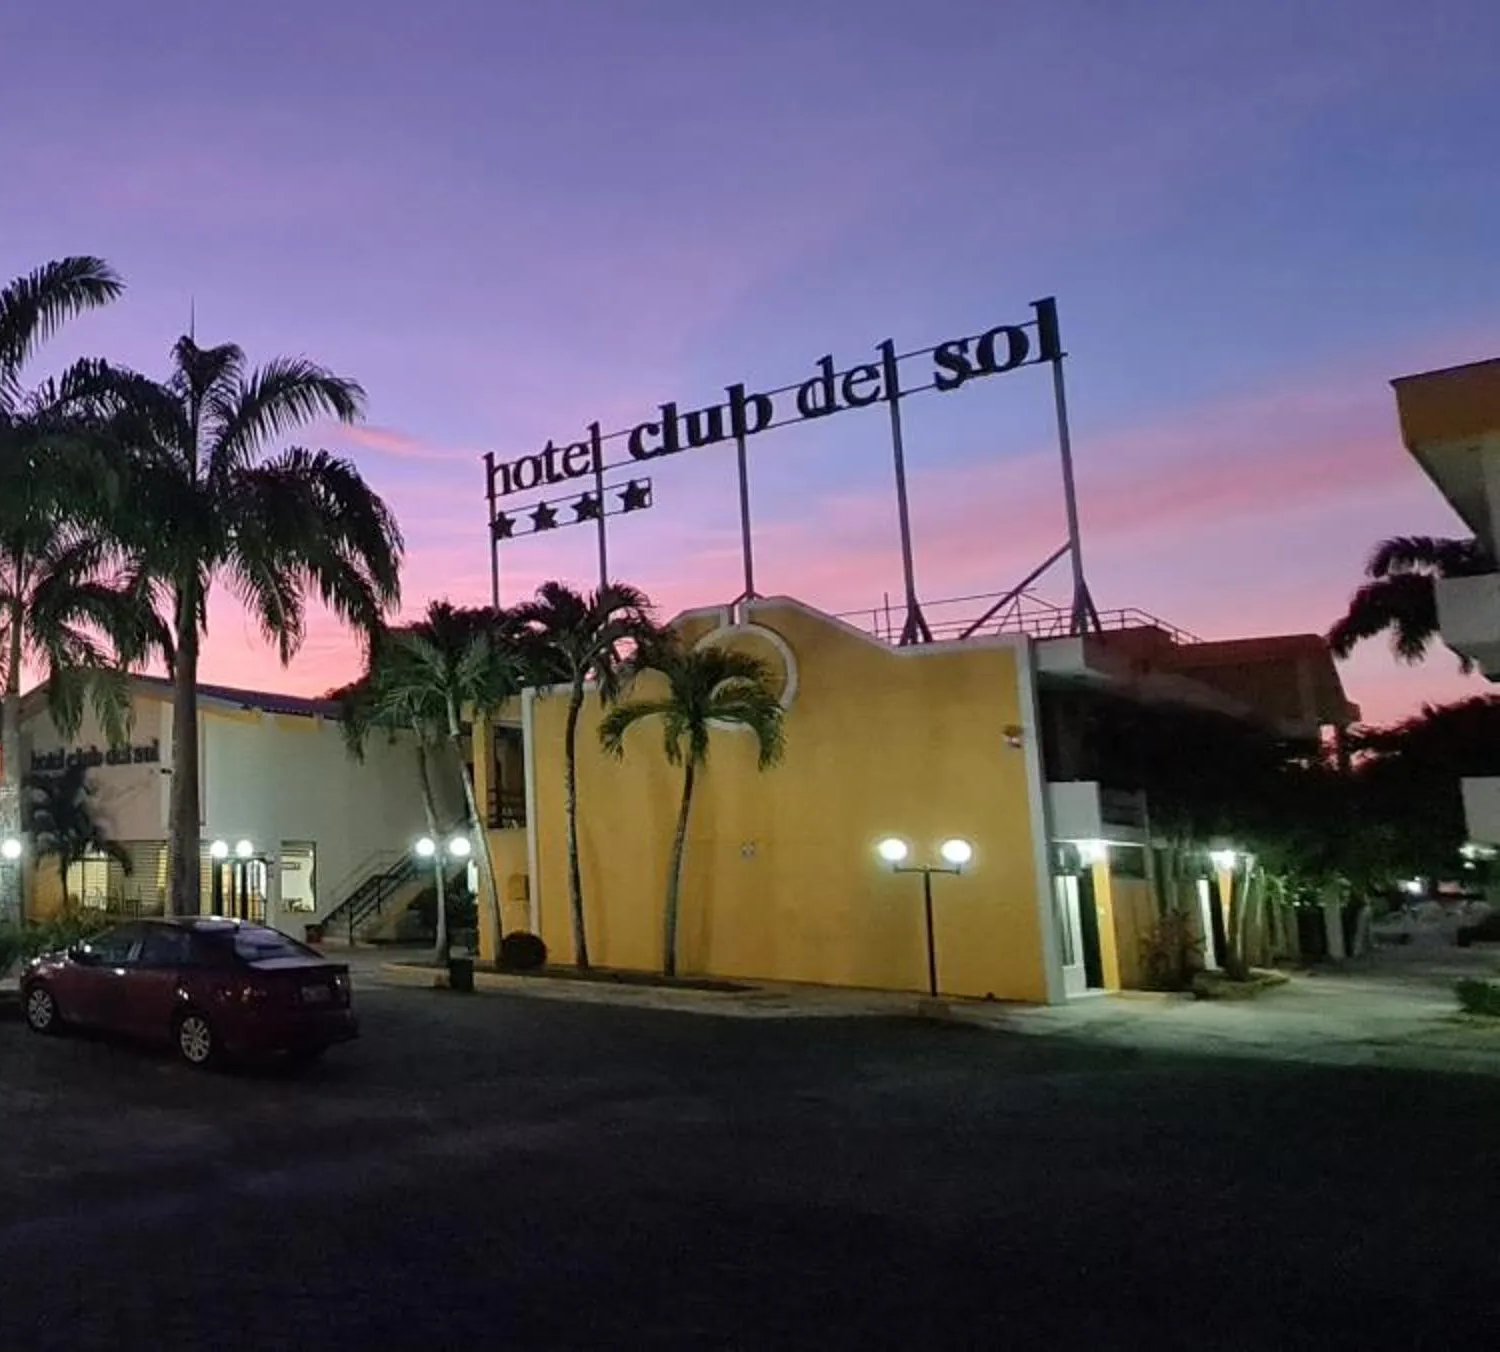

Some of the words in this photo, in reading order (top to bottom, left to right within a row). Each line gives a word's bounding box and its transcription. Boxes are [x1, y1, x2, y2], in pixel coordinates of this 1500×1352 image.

[484, 422, 601, 499] hotel
[628, 383, 773, 461] club
[796, 339, 900, 419] del
[933, 297, 1061, 391] sol
